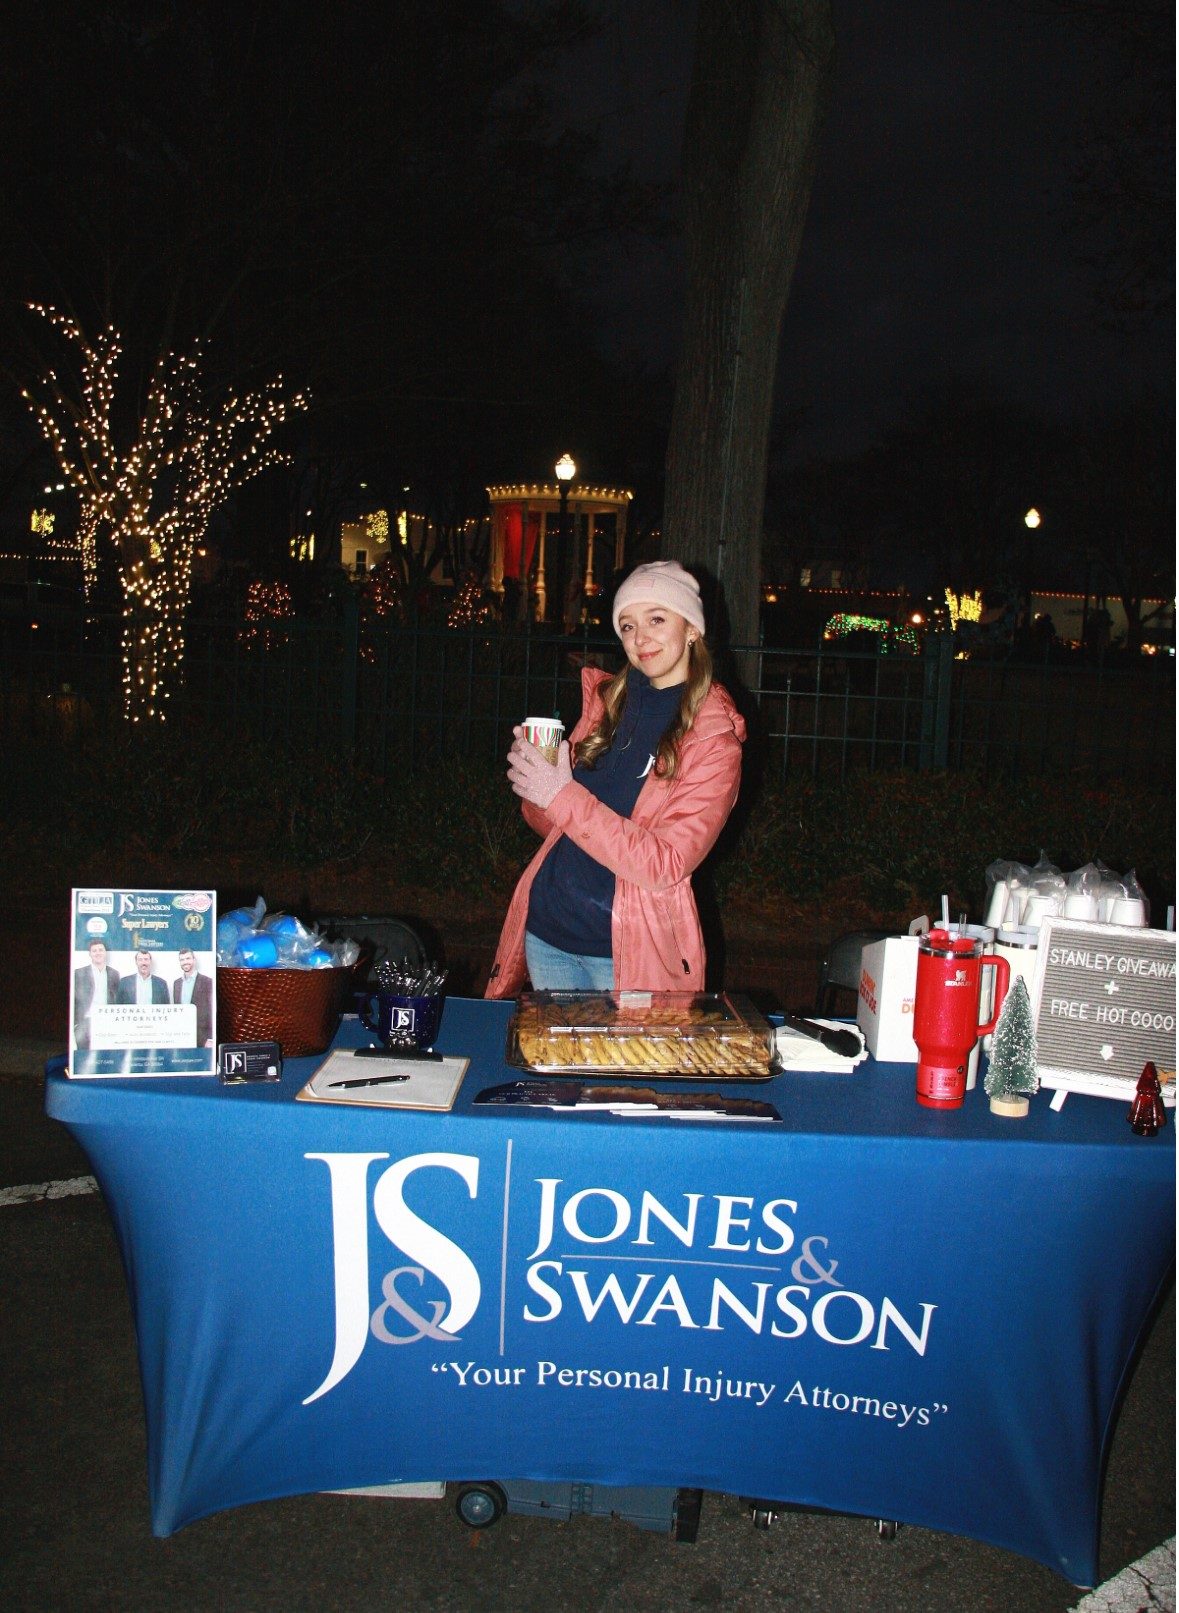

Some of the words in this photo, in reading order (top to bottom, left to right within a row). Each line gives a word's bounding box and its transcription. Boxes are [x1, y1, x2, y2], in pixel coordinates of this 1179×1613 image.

[636, 753, 656, 779] J
[1050, 948, 1114, 970] STANLEY
[1050, 999, 1089, 1020] FREE
[1096, 1006, 1128, 1025] HOT
[1131, 1010, 1174, 1031] COCO
[526, 1178, 798, 1261] JONES
[791, 1235, 844, 1287] &
[523, 1260, 938, 1357] SWANSON
[537, 1365, 669, 1391] Personal
[682, 1368, 776, 1406] Injury
